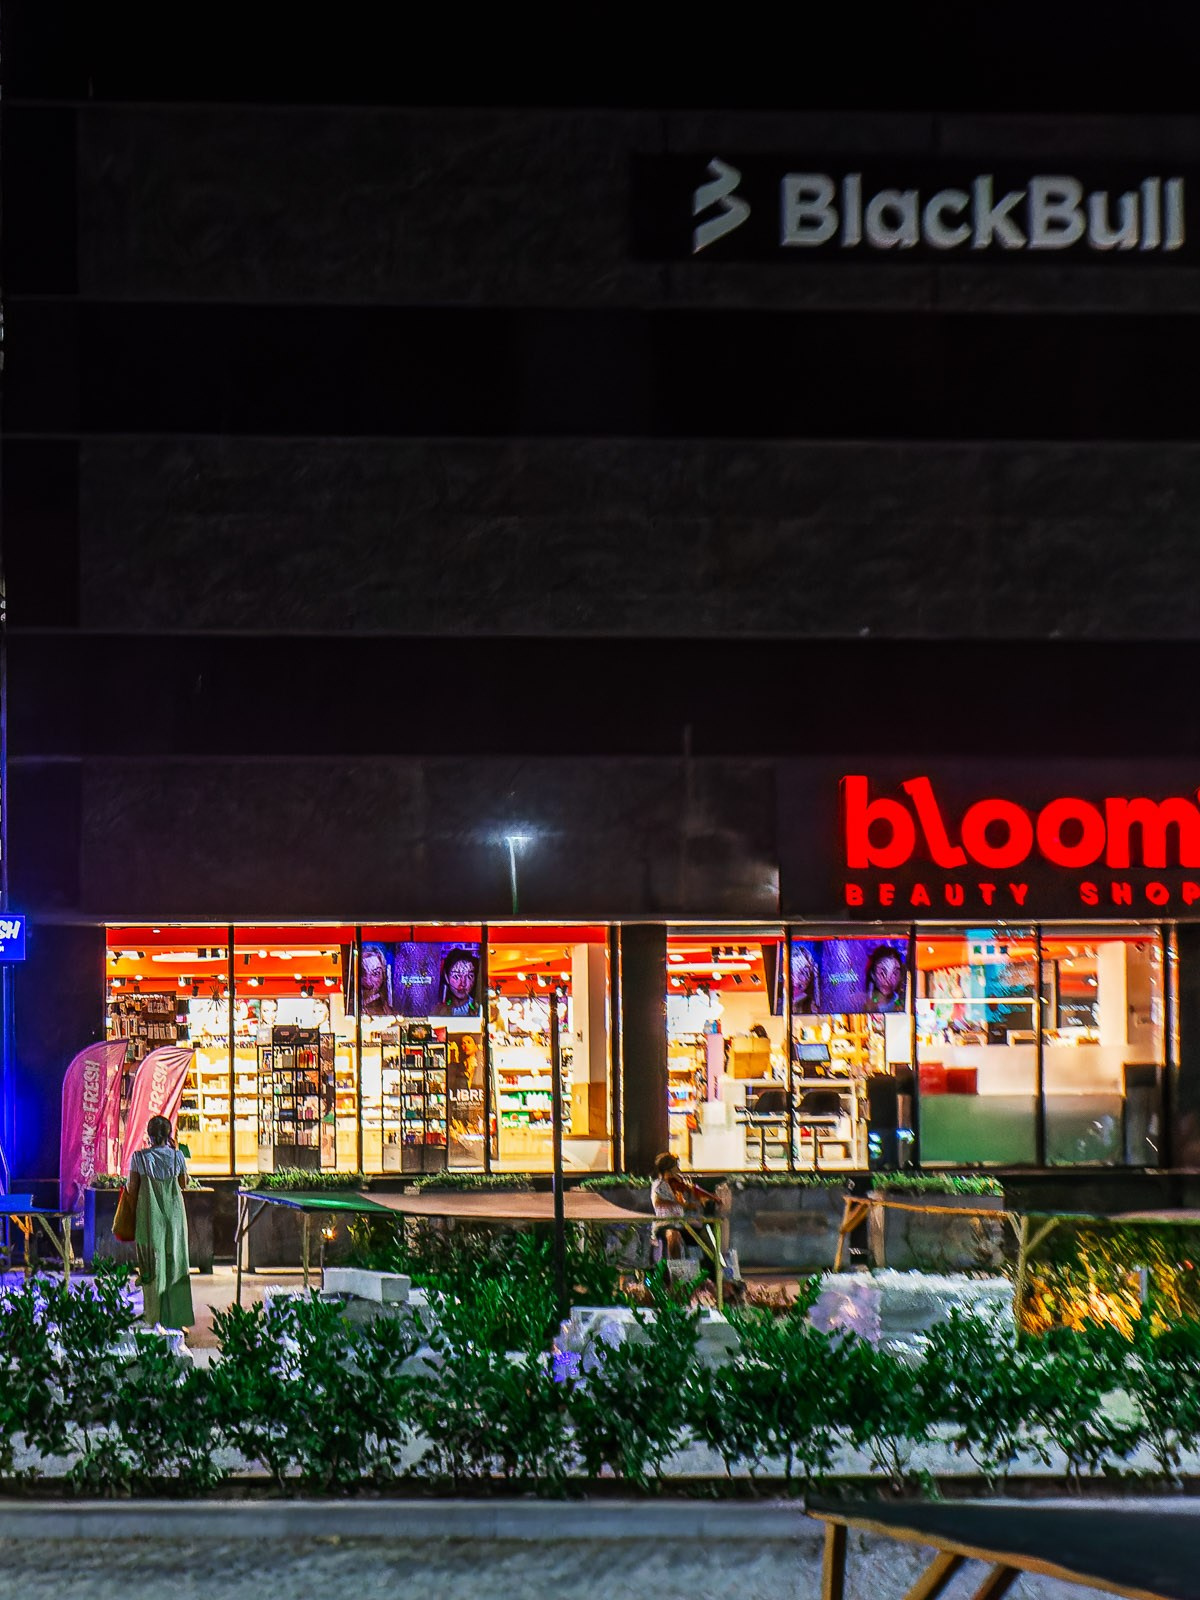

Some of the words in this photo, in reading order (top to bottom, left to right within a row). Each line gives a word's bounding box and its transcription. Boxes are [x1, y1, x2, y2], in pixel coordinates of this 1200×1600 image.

[780, 173, 1185, 250] BlackBull
[841, 775, 1200, 869] bloom
[845, 883, 1028, 906] BEAUTY
[1079, 881, 1200, 906] SHOP
[83, 1060, 100, 1113] FRESH
[148, 1062, 168, 1114] FRESH
[449, 1088, 484, 1101] LIBRE
